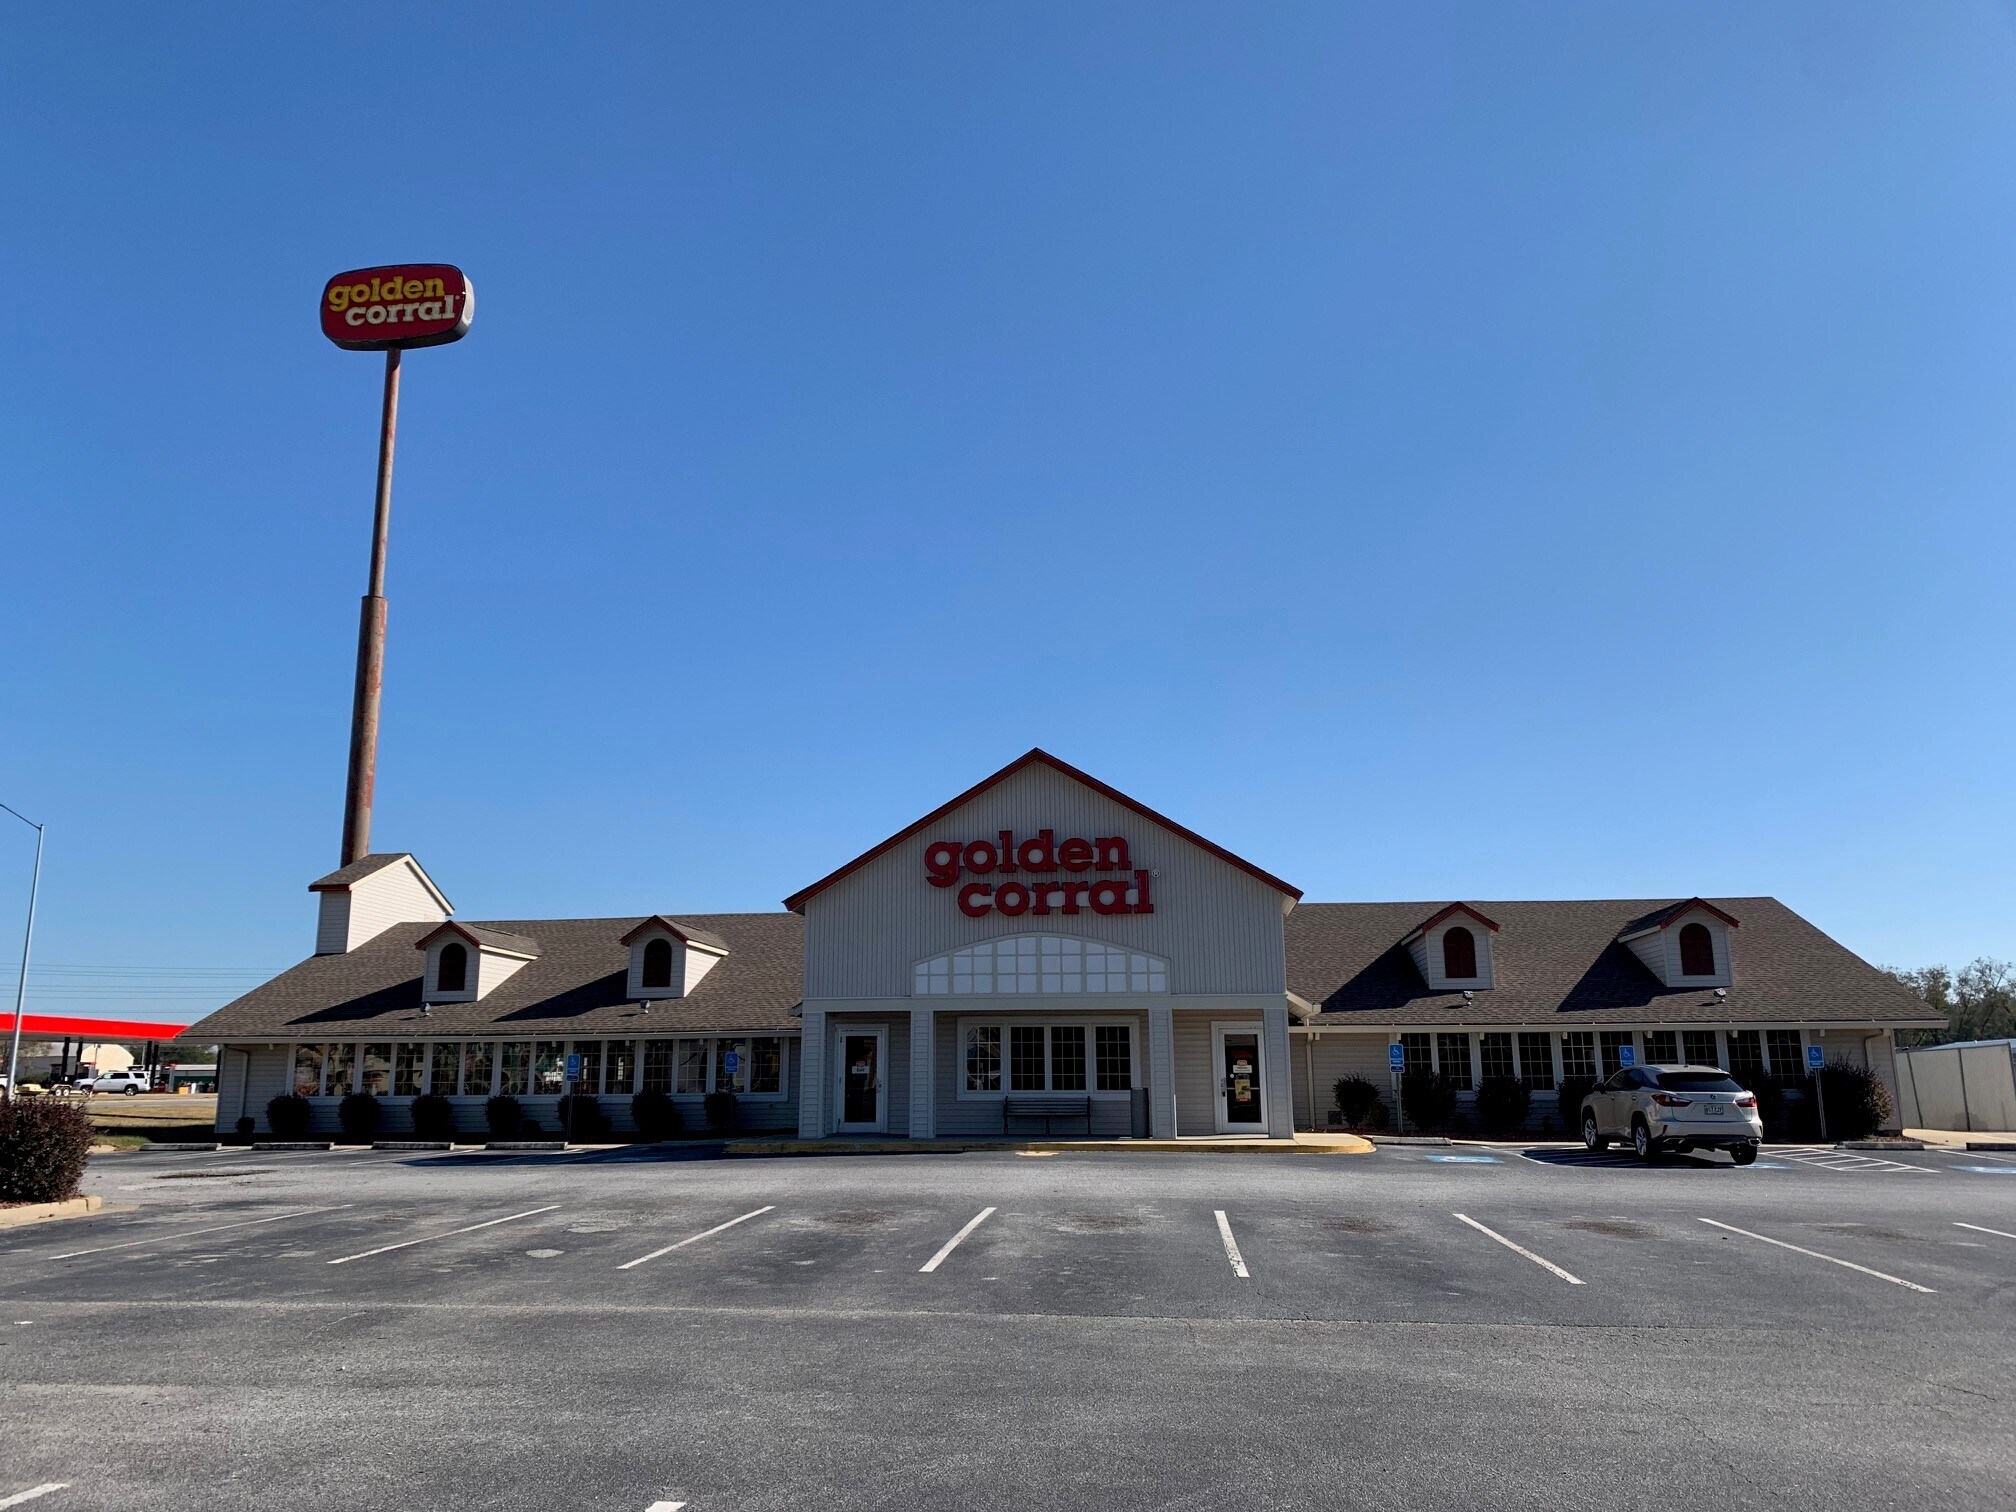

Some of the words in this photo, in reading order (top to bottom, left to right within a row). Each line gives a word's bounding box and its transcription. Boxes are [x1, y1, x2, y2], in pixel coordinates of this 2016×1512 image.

[328, 275, 445, 312] golden
[345, 294, 455, 326] corral
[924, 829, 1132, 888] golden
[957, 869, 1154, 918] corral
